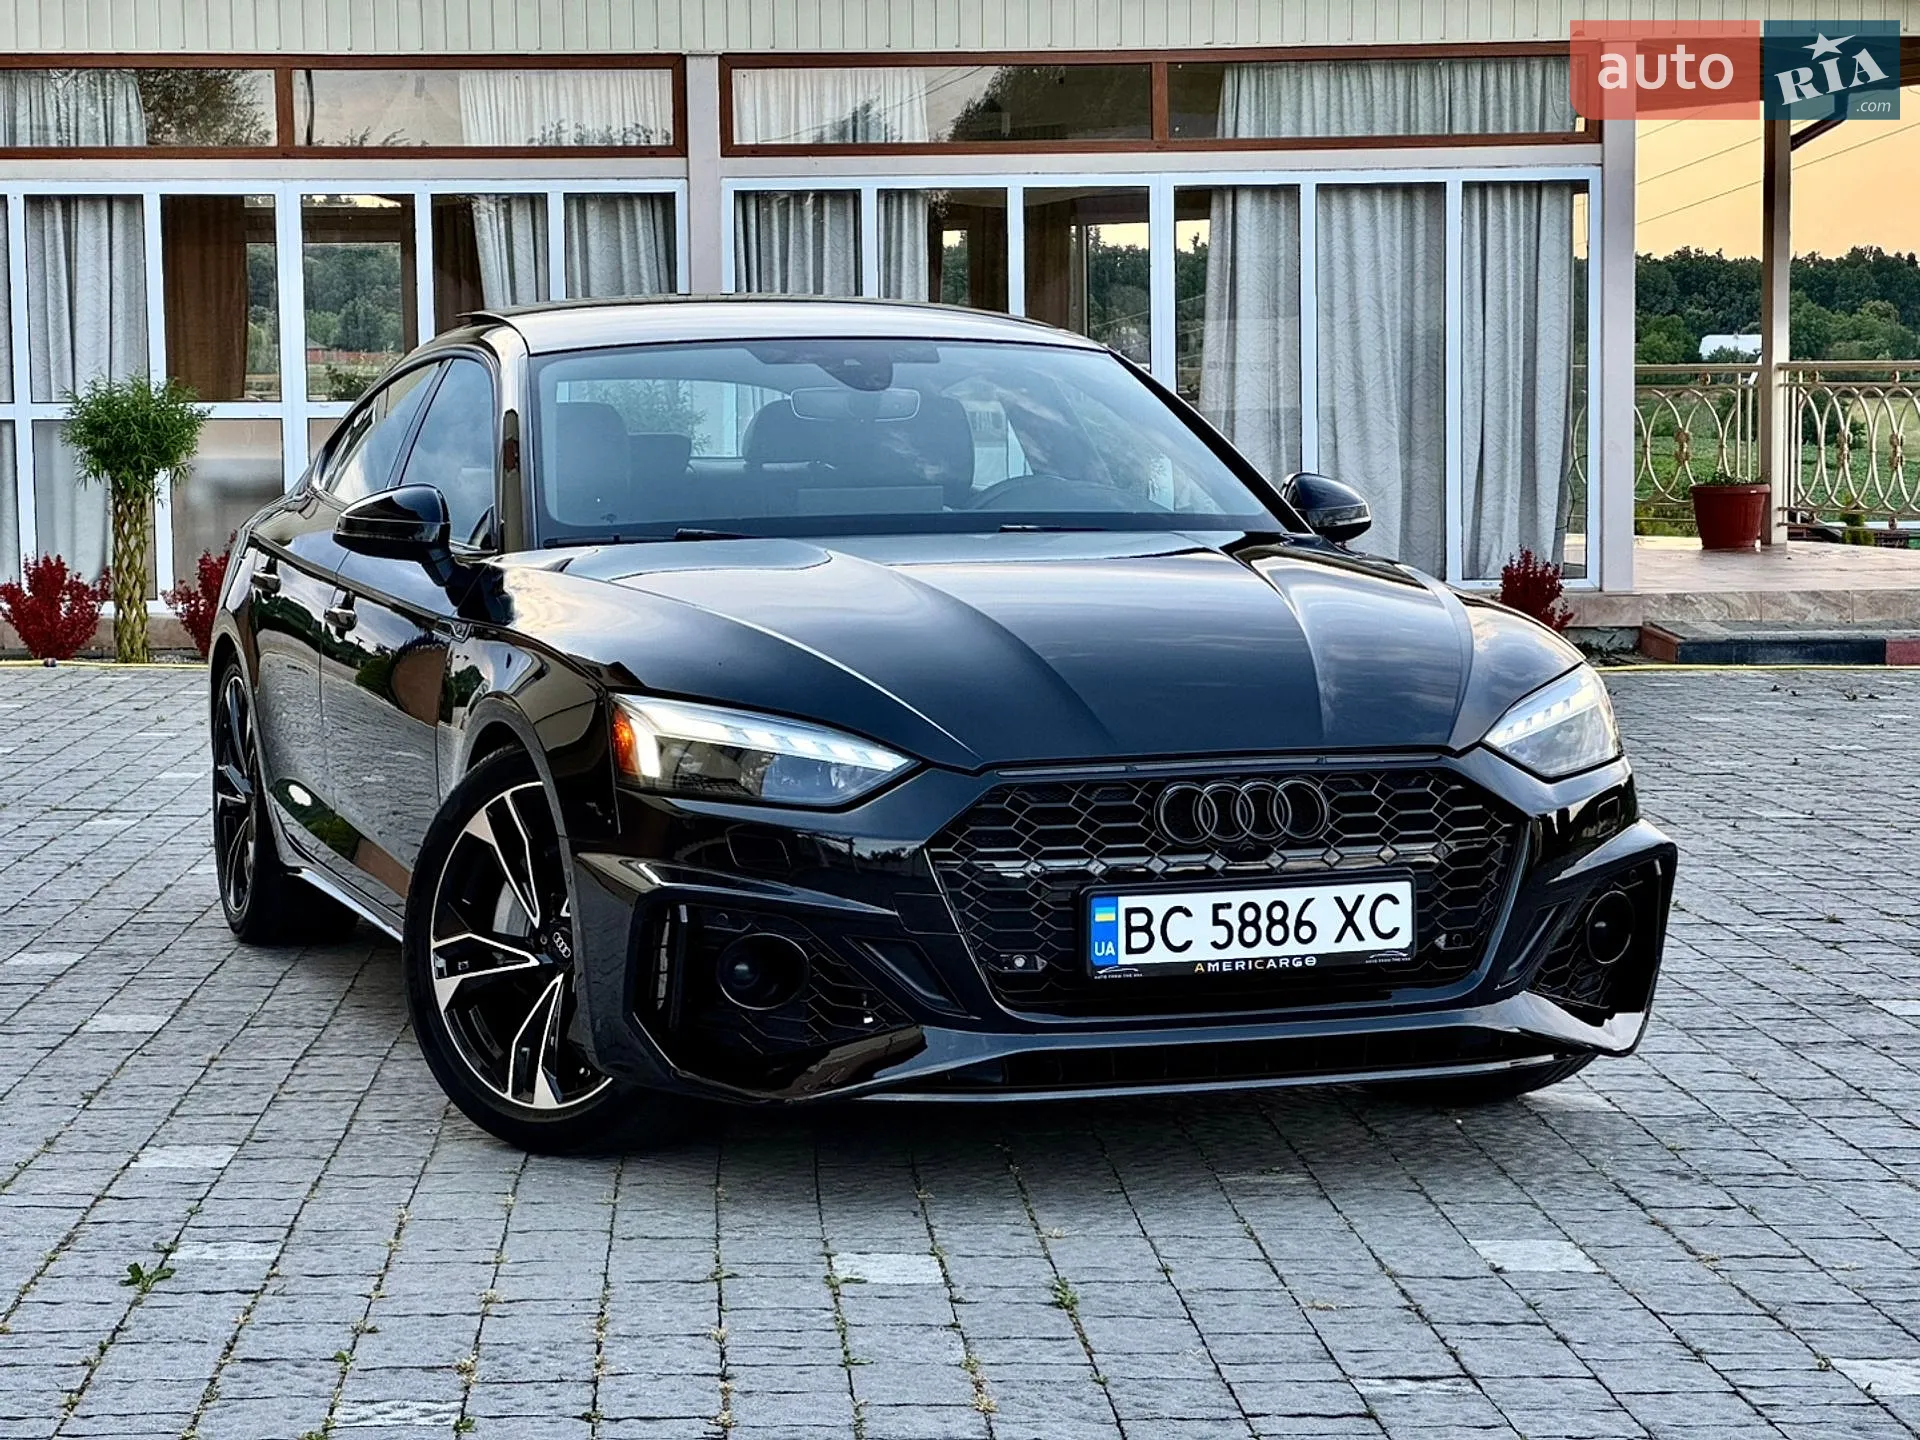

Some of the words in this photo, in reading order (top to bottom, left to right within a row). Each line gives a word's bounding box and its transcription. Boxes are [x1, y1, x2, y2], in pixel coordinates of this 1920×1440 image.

[1125, 905, 1193, 955] BC
[1210, 898, 1317, 950] 5886
[1333, 893, 1400, 944] XC
[1094, 941, 1116, 957] UA
[1194, 956, 1317, 973] AMERICARGO
